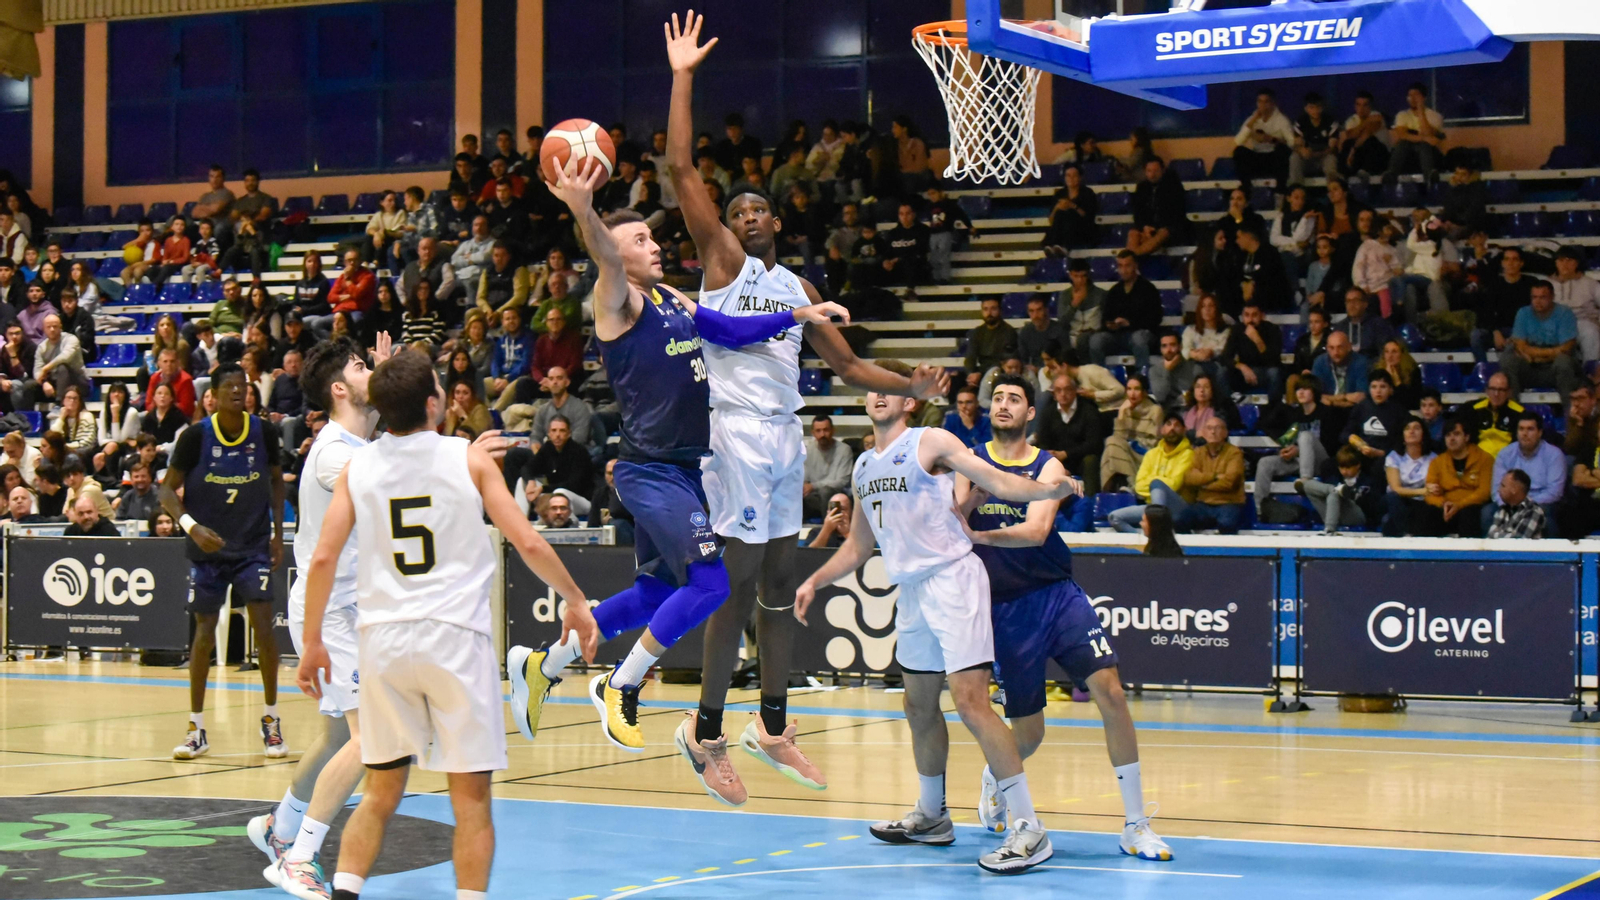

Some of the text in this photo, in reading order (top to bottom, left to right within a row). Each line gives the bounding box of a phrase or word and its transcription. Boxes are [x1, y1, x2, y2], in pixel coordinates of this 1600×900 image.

[1156, 17, 1363, 52] SPORT SYSTEM
[690, 357, 707, 382] 30
[226, 488, 238, 504] 7
[872, 500, 883, 528] 7
[389, 494, 436, 576] 5
[90, 553, 155, 605] ice
[259, 575, 269, 591] 7
[1090, 636, 1113, 658] 14
[1151, 634, 1230, 650] de Algeciras
[1434, 648, 1489, 658] CATERING
